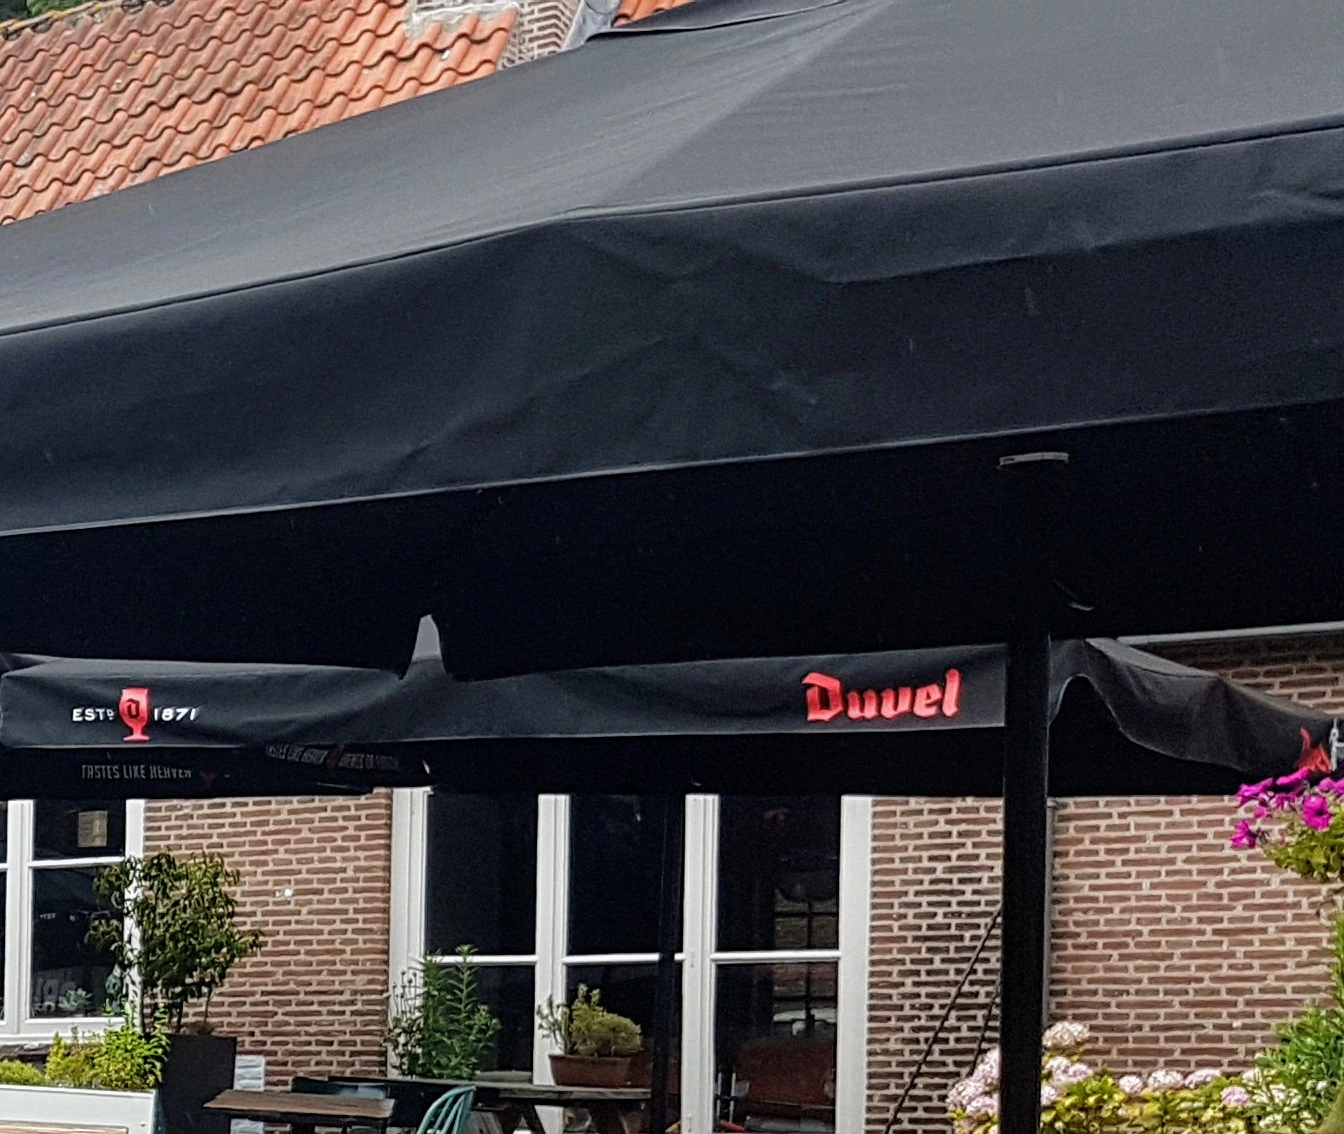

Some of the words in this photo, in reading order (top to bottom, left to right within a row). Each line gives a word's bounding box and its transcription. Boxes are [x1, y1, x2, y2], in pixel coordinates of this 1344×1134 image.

[801, 667, 962, 722] Duvel
[153, 707, 197, 722] 1871
[80, 763, 120, 780] TASTES
[122, 763, 147, 780] LIKE
